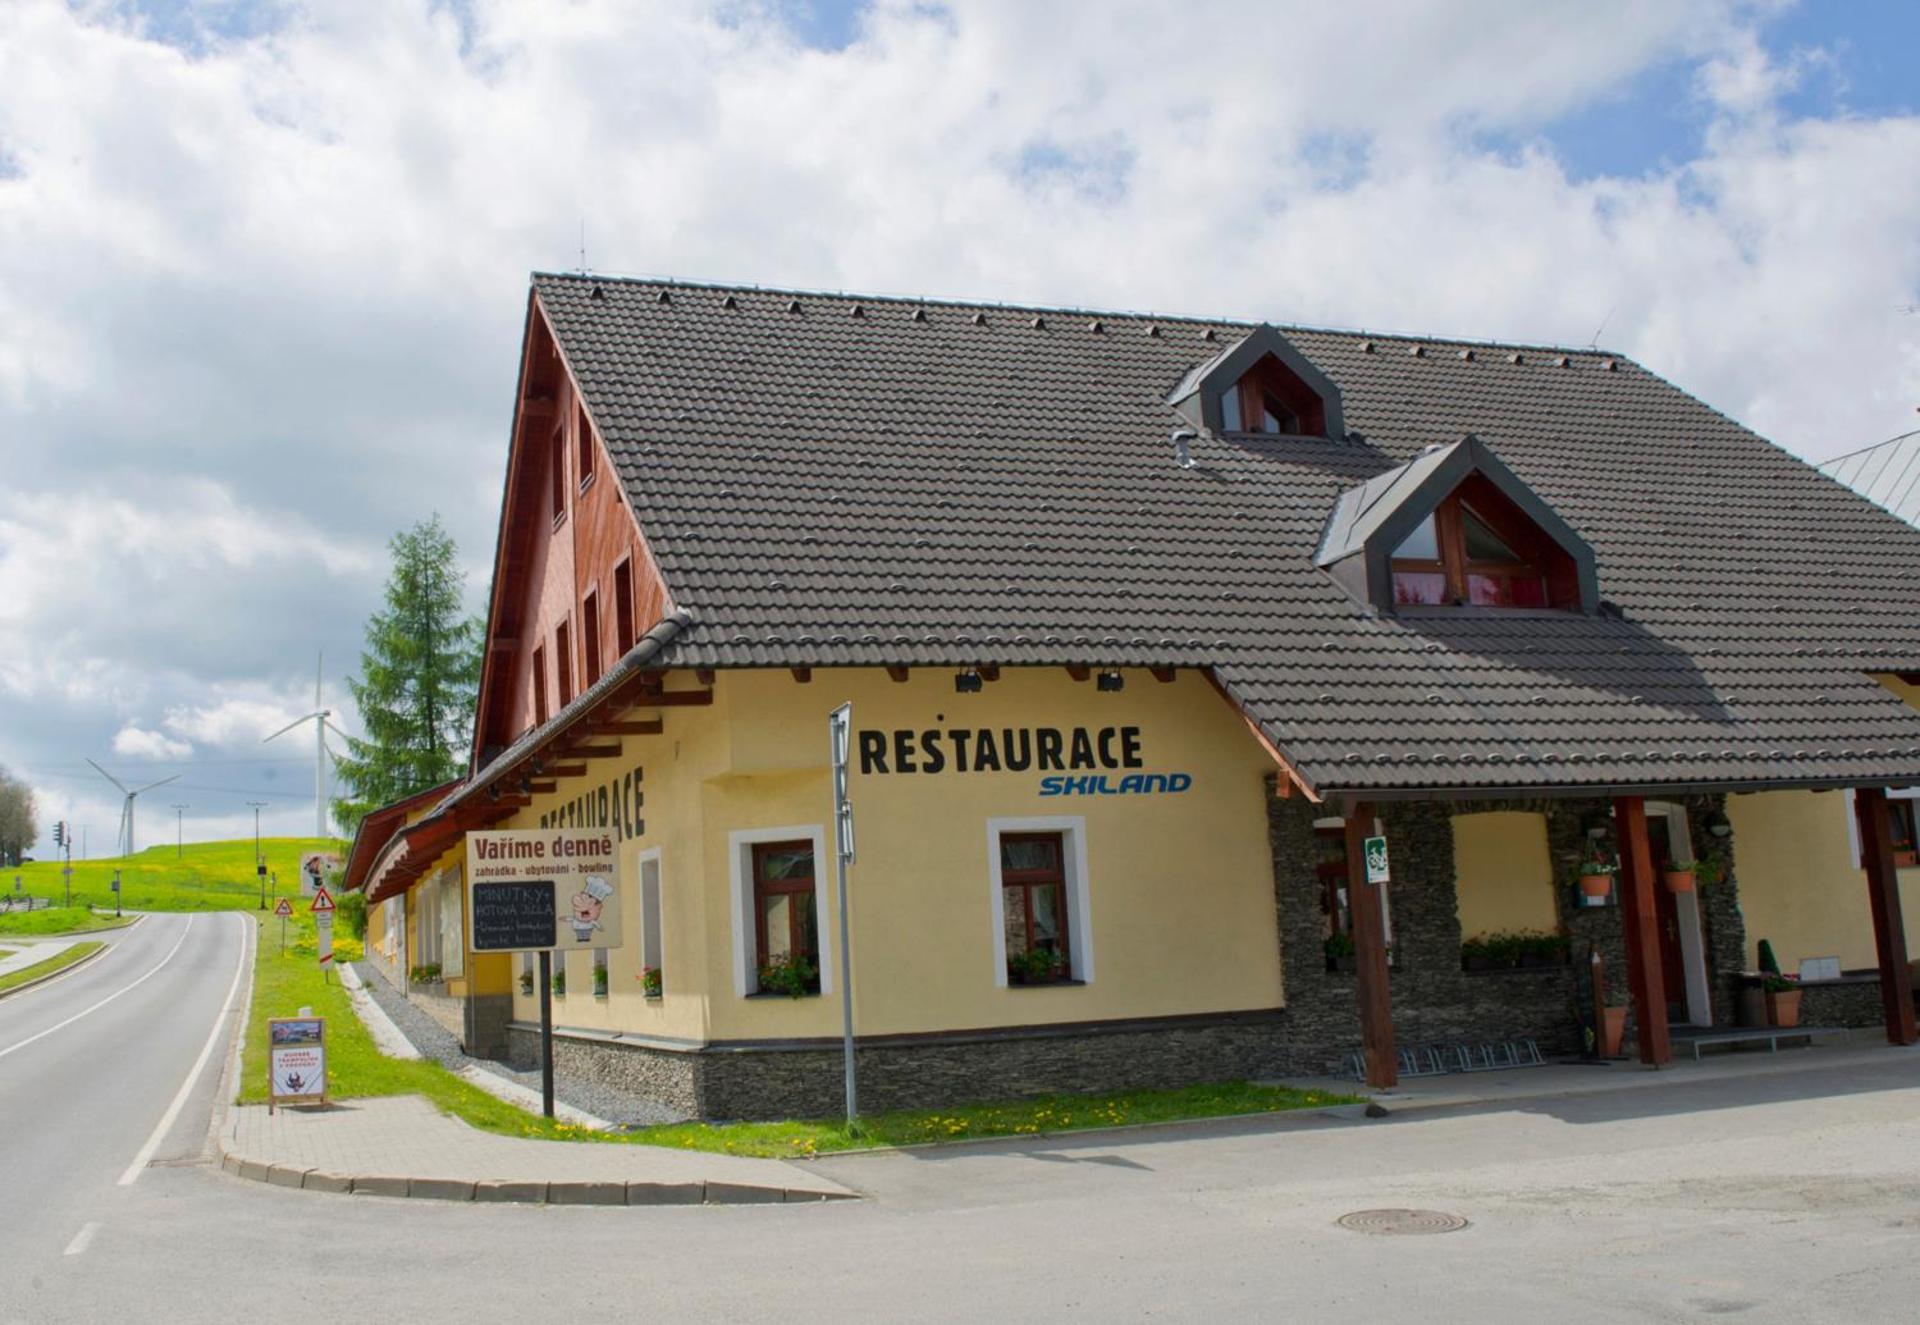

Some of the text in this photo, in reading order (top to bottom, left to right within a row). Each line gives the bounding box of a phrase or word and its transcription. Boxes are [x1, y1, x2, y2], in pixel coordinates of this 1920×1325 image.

[858, 726, 1143, 775] RESTAURACE
[1038, 773, 1192, 796] SKILAND
[540, 766, 645, 843] TAURACE
[475, 835, 612, 860] Vaříme denně
[475, 865, 516, 877] zahrádka
[525, 864, 569, 877] ubytování
[578, 863, 613, 874] bowling
